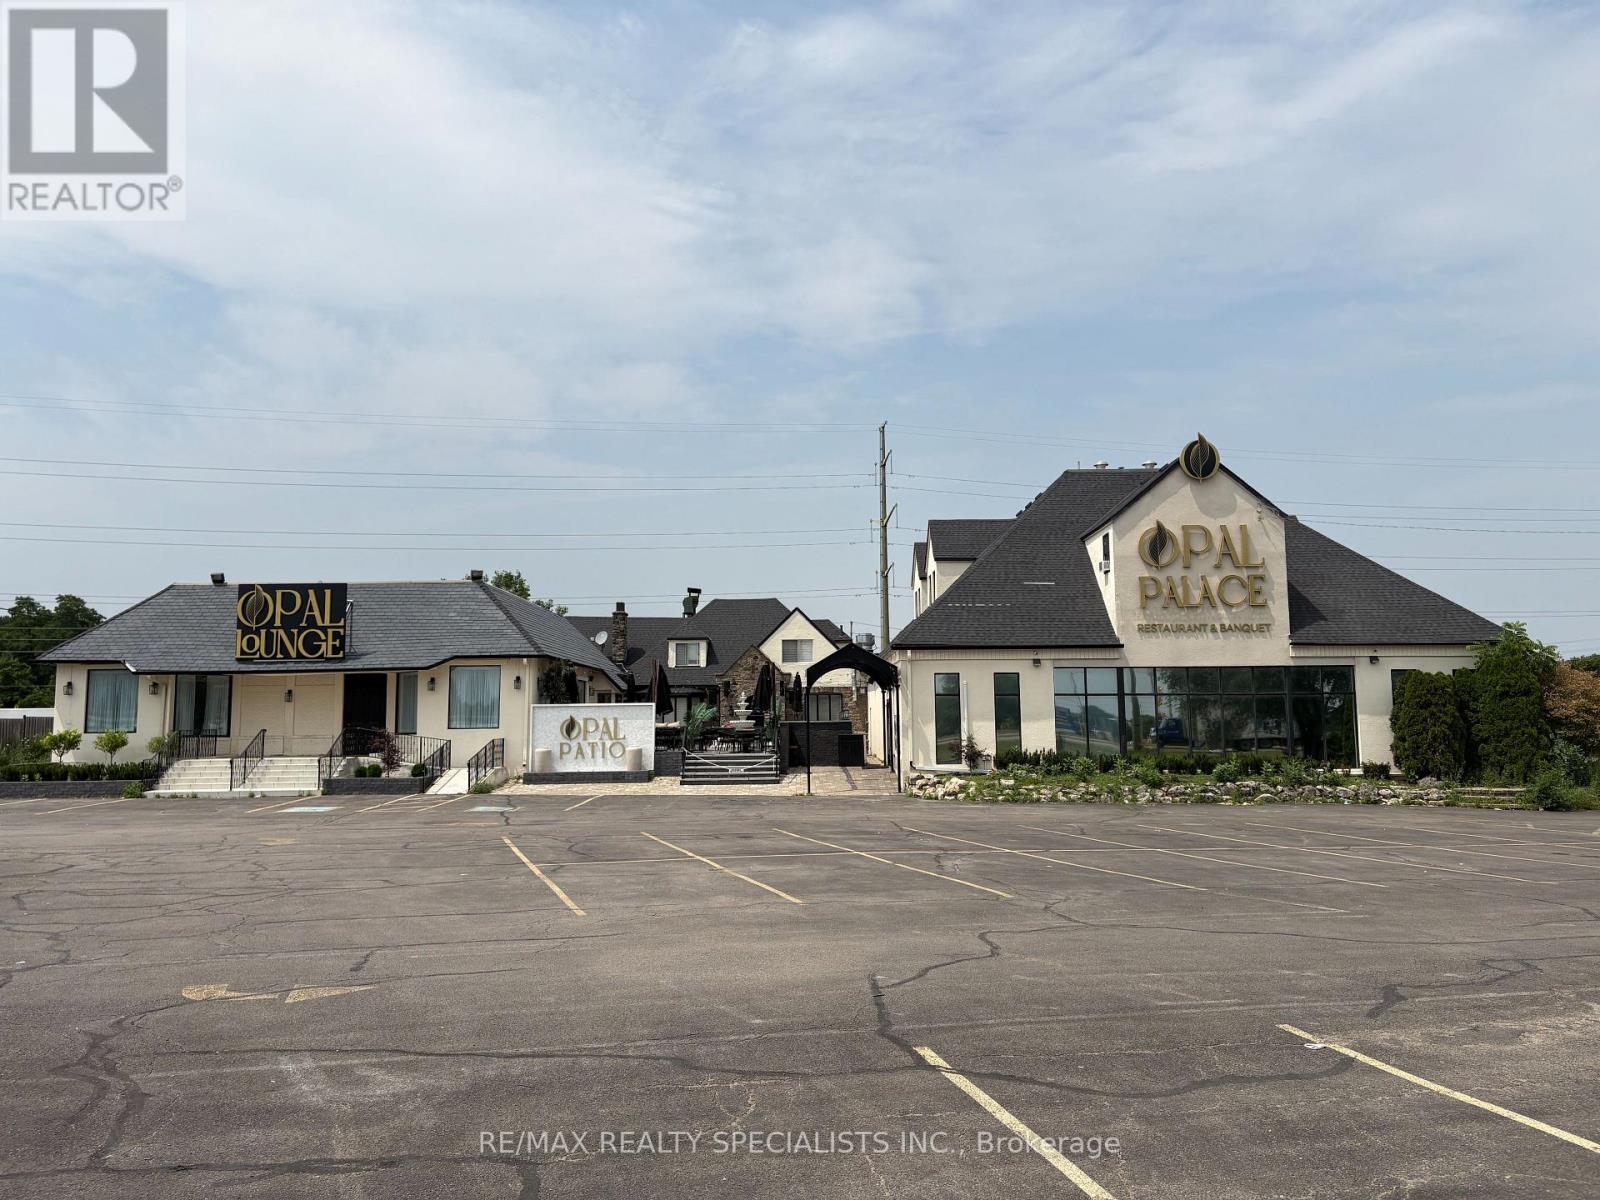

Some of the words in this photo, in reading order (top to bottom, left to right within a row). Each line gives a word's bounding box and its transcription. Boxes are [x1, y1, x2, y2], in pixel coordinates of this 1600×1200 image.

[1138, 519, 1265, 570] OPAL
[1138, 574, 1268, 609] PALACE
[237, 584, 345, 630] OPAL
[1137, 623, 1208, 633] RESTAURANT
[1210, 624, 1218, 633] &
[1220, 623, 1271, 633] BANQUET
[560, 715, 626, 741] OPAL
[560, 741, 626, 760] PATIO
